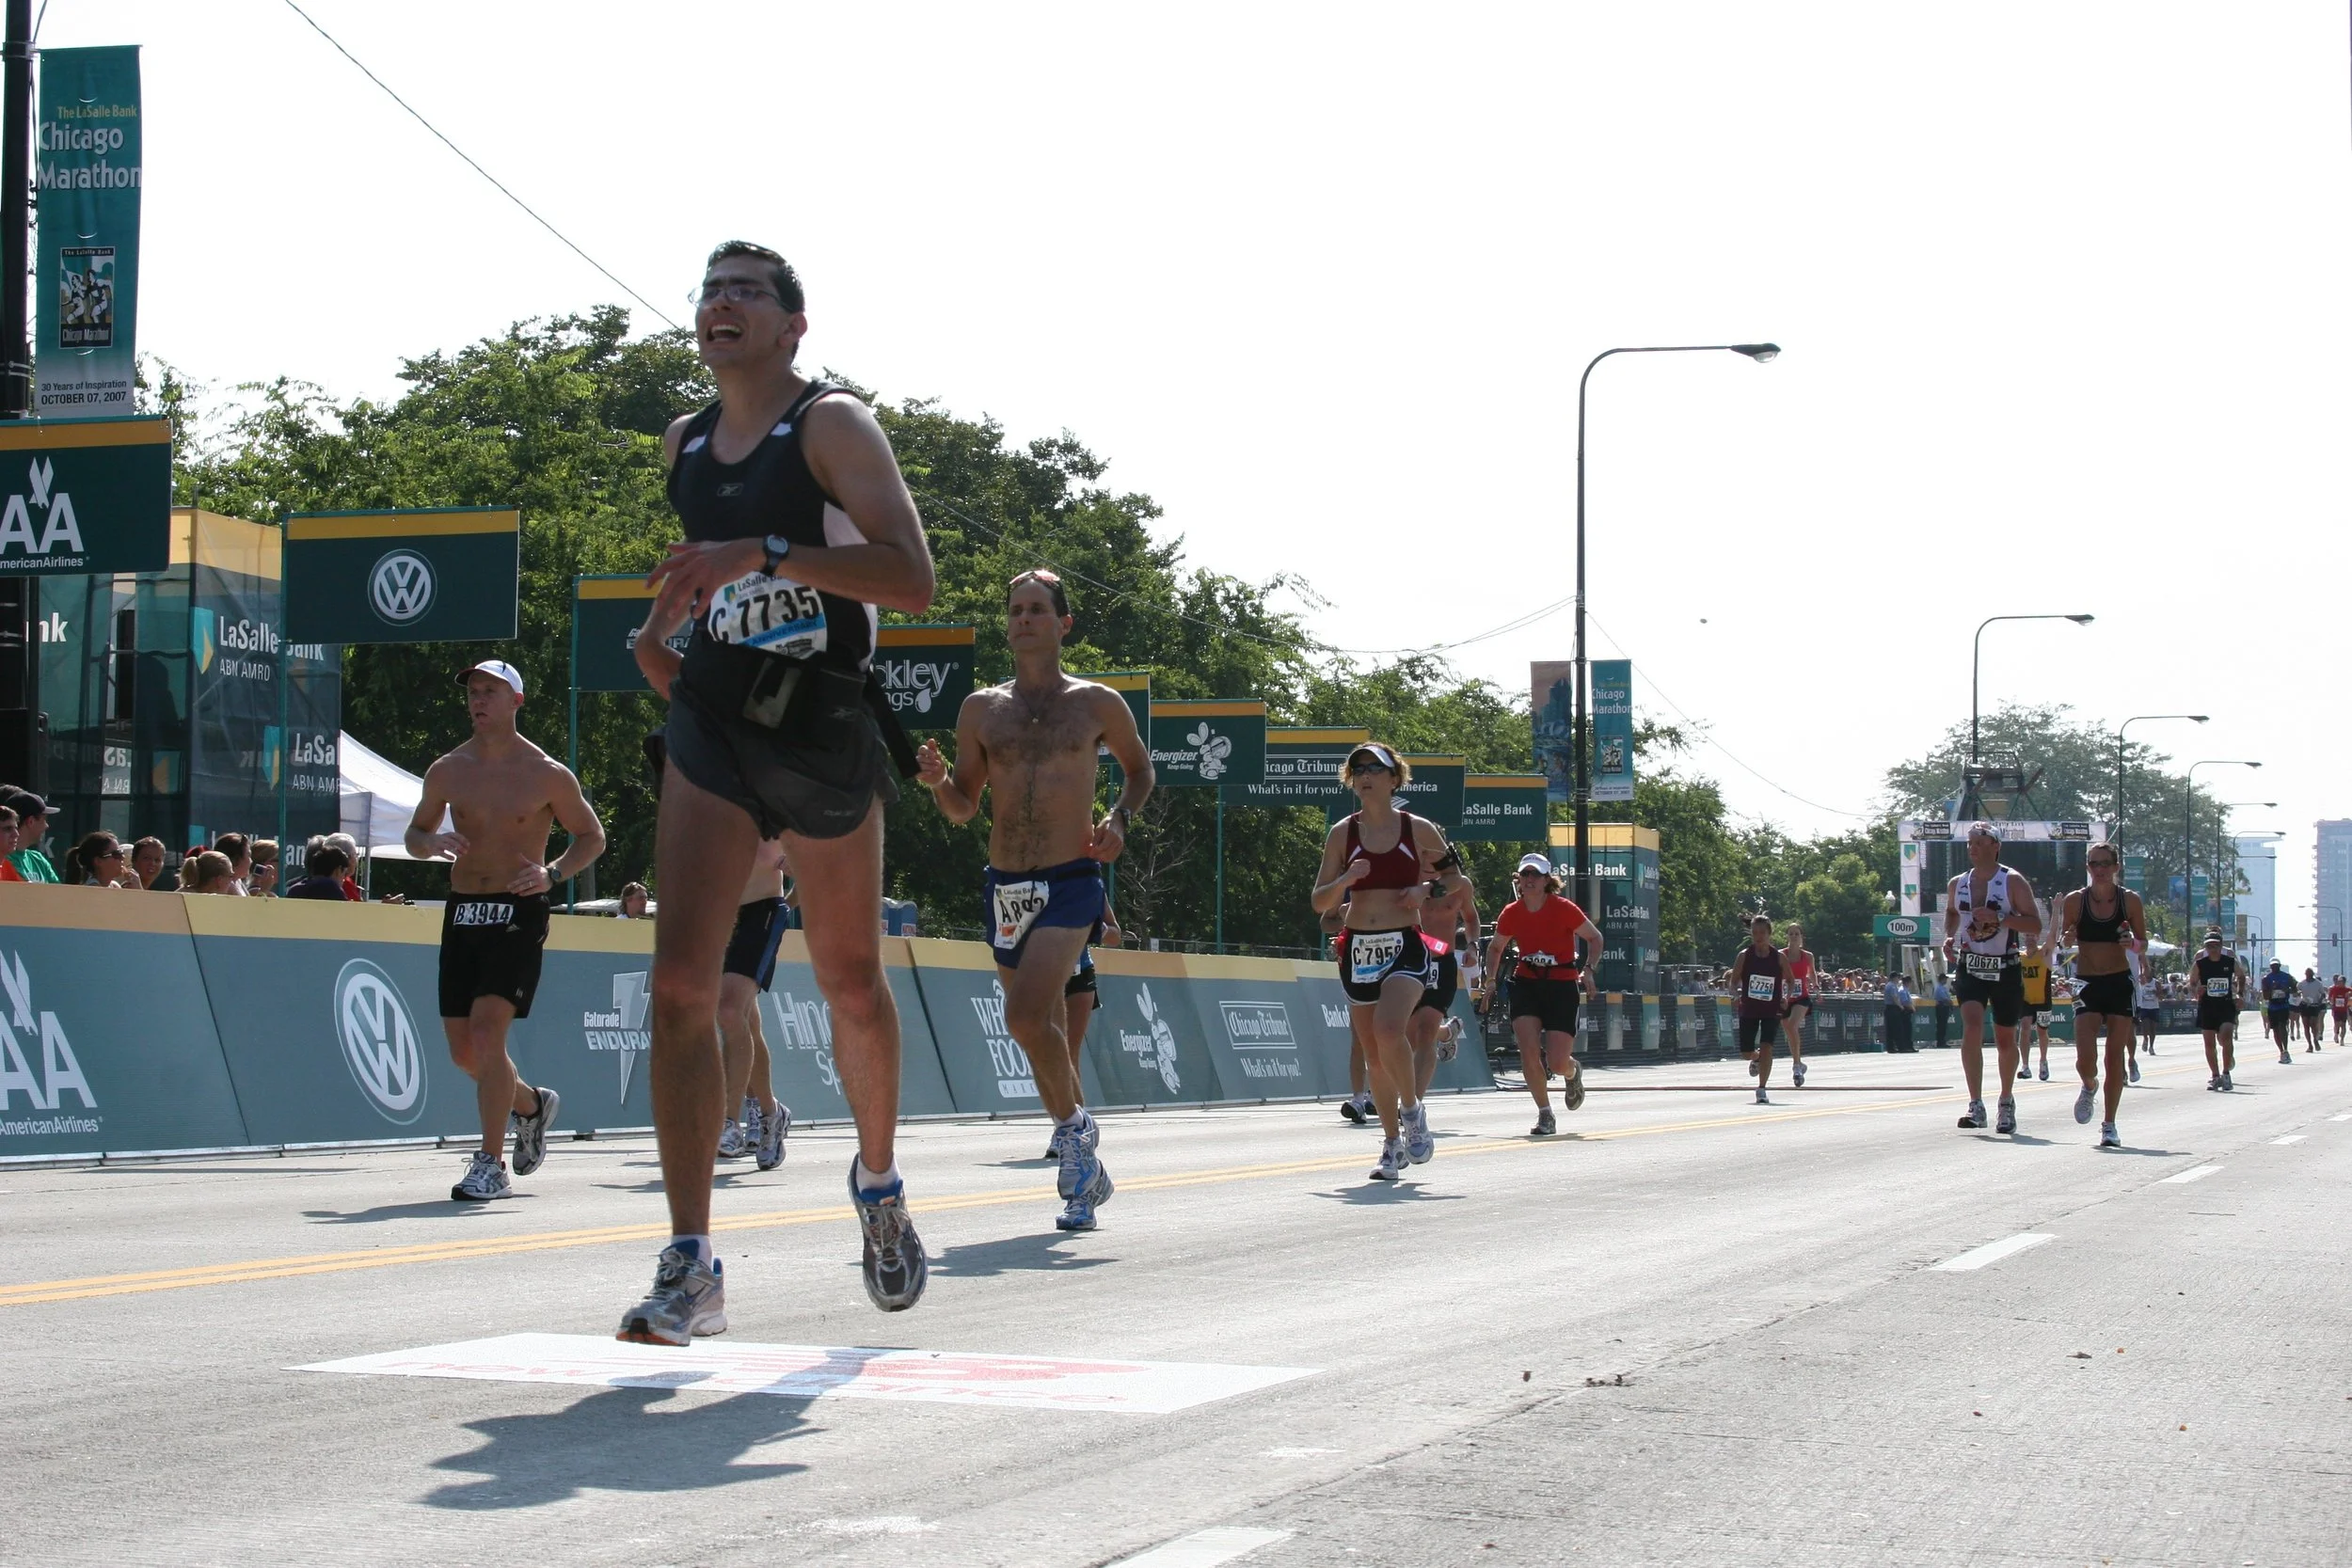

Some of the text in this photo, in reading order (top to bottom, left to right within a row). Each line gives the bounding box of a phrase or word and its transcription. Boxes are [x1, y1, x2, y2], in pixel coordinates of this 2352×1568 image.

[57, 104, 137, 119] The LaSalle Bank
[40, 121, 124, 155] Chicago
[39, 158, 142, 190] Marathon
[41, 379, 127, 391] 30 Years of Inspiration
[40, 391, 127, 405] OCTOBER 07, 2007
[0, 556, 84, 569] mericanAirlines
[710, 586, 819, 643] C 7735
[219, 615, 279, 655] LaSalle
[219, 658, 271, 682] ABN AMRO
[1591, 688, 1626, 702] Chicago
[1150, 749, 1198, 764] Energizer
[292, 774, 315, 791] ABN
[1248, 783, 1344, 797] What's in it for you?
[1462, 803, 1533, 816] aSalle Bank
[1595, 863, 1627, 877] Bank
[455, 903, 511, 924] B 3944
[998, 899, 1012, 924] A
[1890, 923, 1915, 932] 100m
[1352, 946, 1362, 966] C
[1968, 954, 1999, 970] 20678
[2022, 965, 2040, 978] CAT
[583, 1011, 620, 1028] Gatorade
[1228, 1009, 1290, 1039] Chicago Tribune
[1321, 1004, 1343, 1027] Bank
[2049, 1012, 2066, 1022] ank
[584, 1031, 652, 1051] ENDURA
[1120, 1029, 1154, 1057] Energizer
